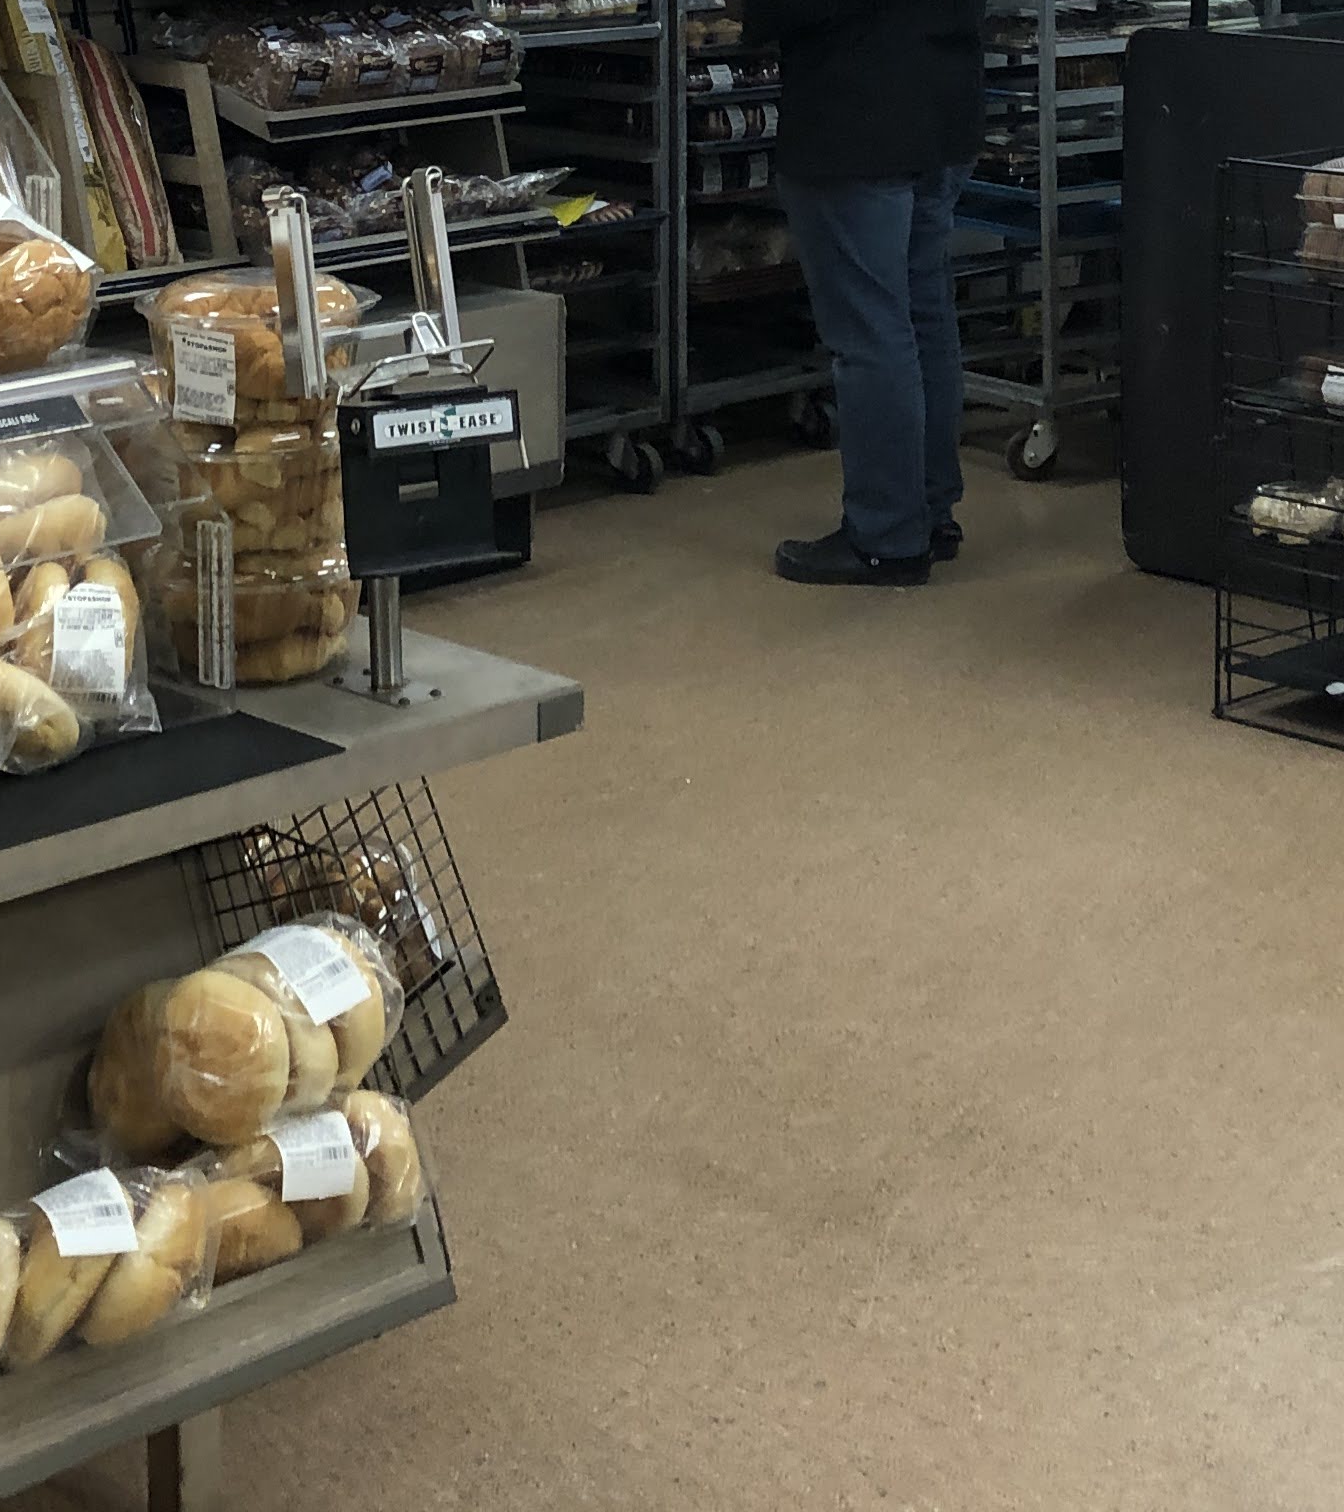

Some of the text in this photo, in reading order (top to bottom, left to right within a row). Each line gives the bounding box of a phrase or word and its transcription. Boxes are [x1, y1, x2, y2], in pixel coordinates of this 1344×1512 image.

[19, 412, 41, 424] ROLL
[388, 413, 498, 437] TWIST EASE
